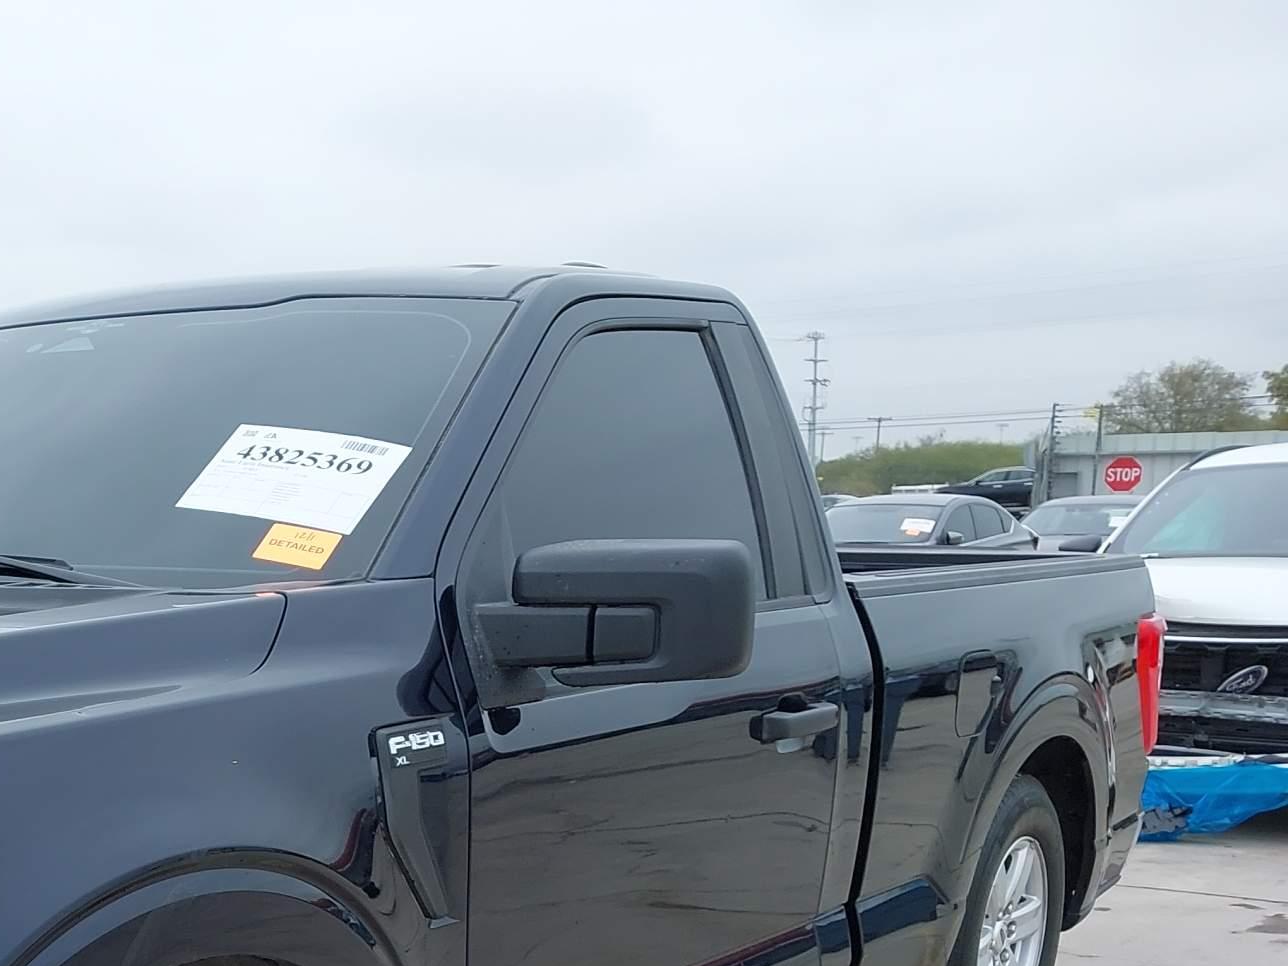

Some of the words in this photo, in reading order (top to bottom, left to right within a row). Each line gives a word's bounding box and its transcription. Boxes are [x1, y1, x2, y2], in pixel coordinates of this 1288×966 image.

[236, 444, 374, 476] 43825369
[1106, 467, 1141, 482] STOP
[268, 538, 325, 555] DETAILED
[388, 730, 445, 755] F-150
[395, 755, 411, 767] XL
